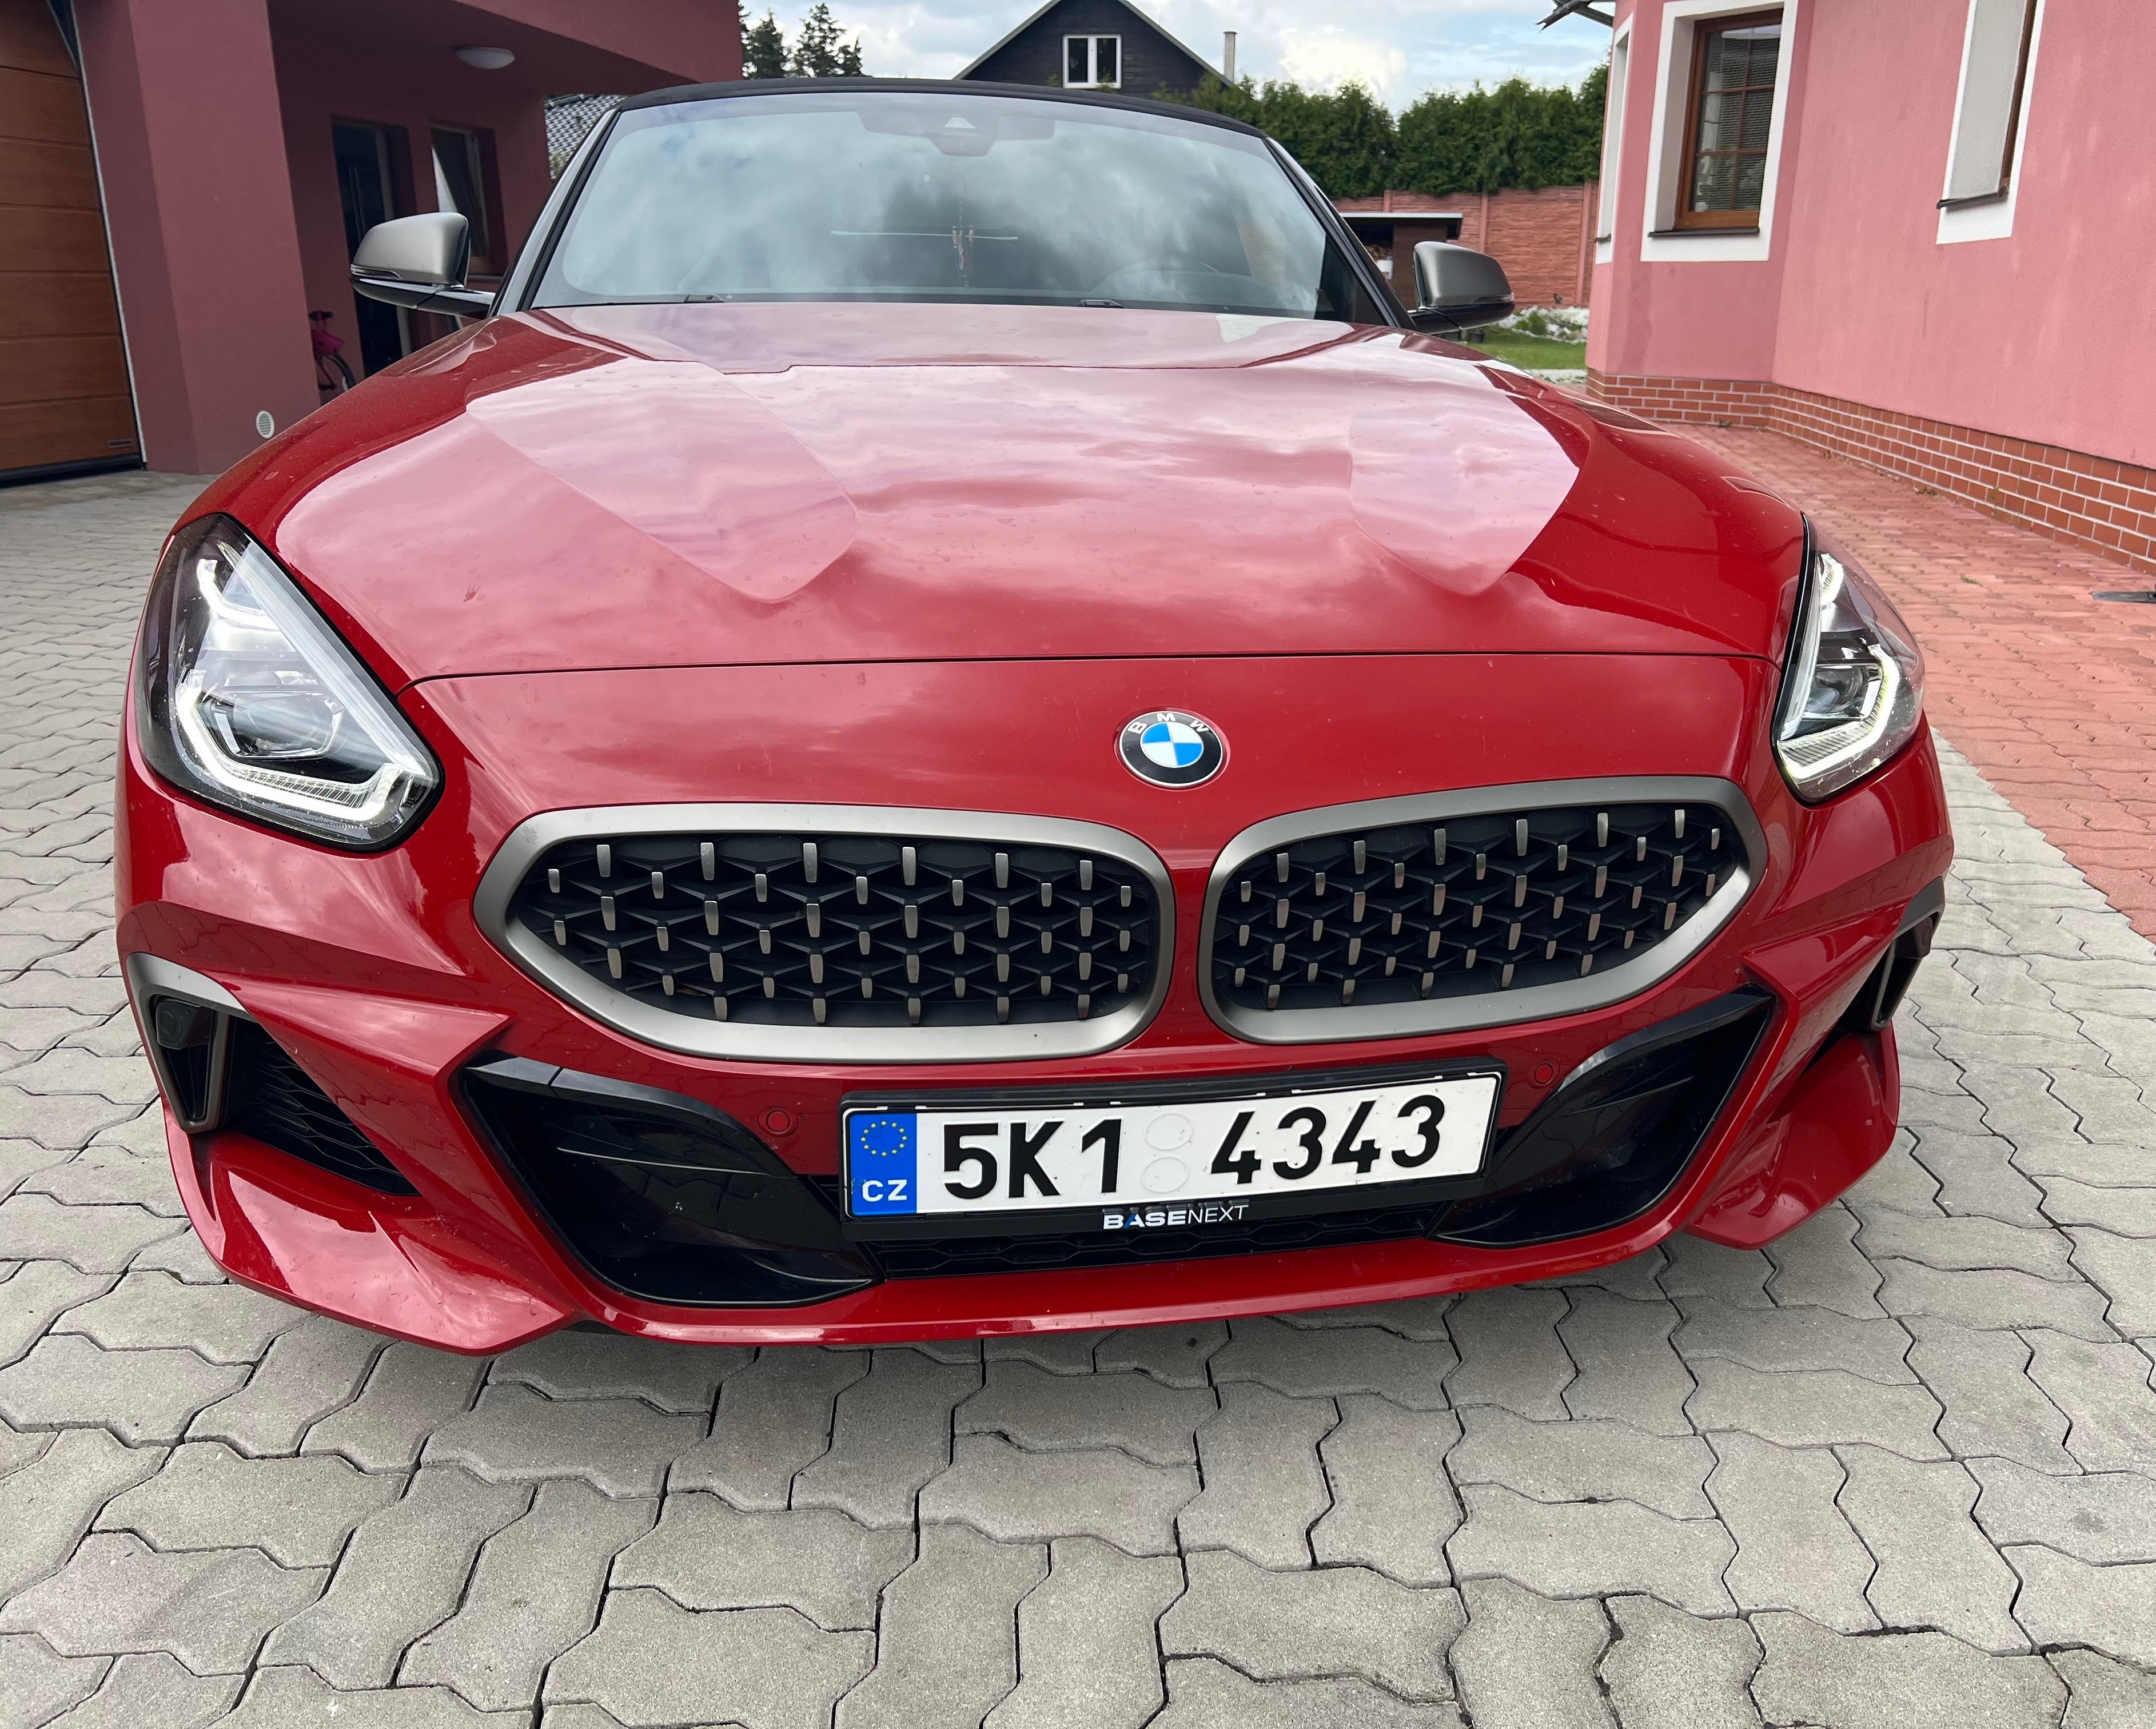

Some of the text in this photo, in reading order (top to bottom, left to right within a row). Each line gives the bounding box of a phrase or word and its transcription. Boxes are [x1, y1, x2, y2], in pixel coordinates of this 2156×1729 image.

[1127, 712, 1209, 735] BMW
[943, 1094, 1445, 1200] 5K1 4343
[862, 1179, 908, 1202] CZ
